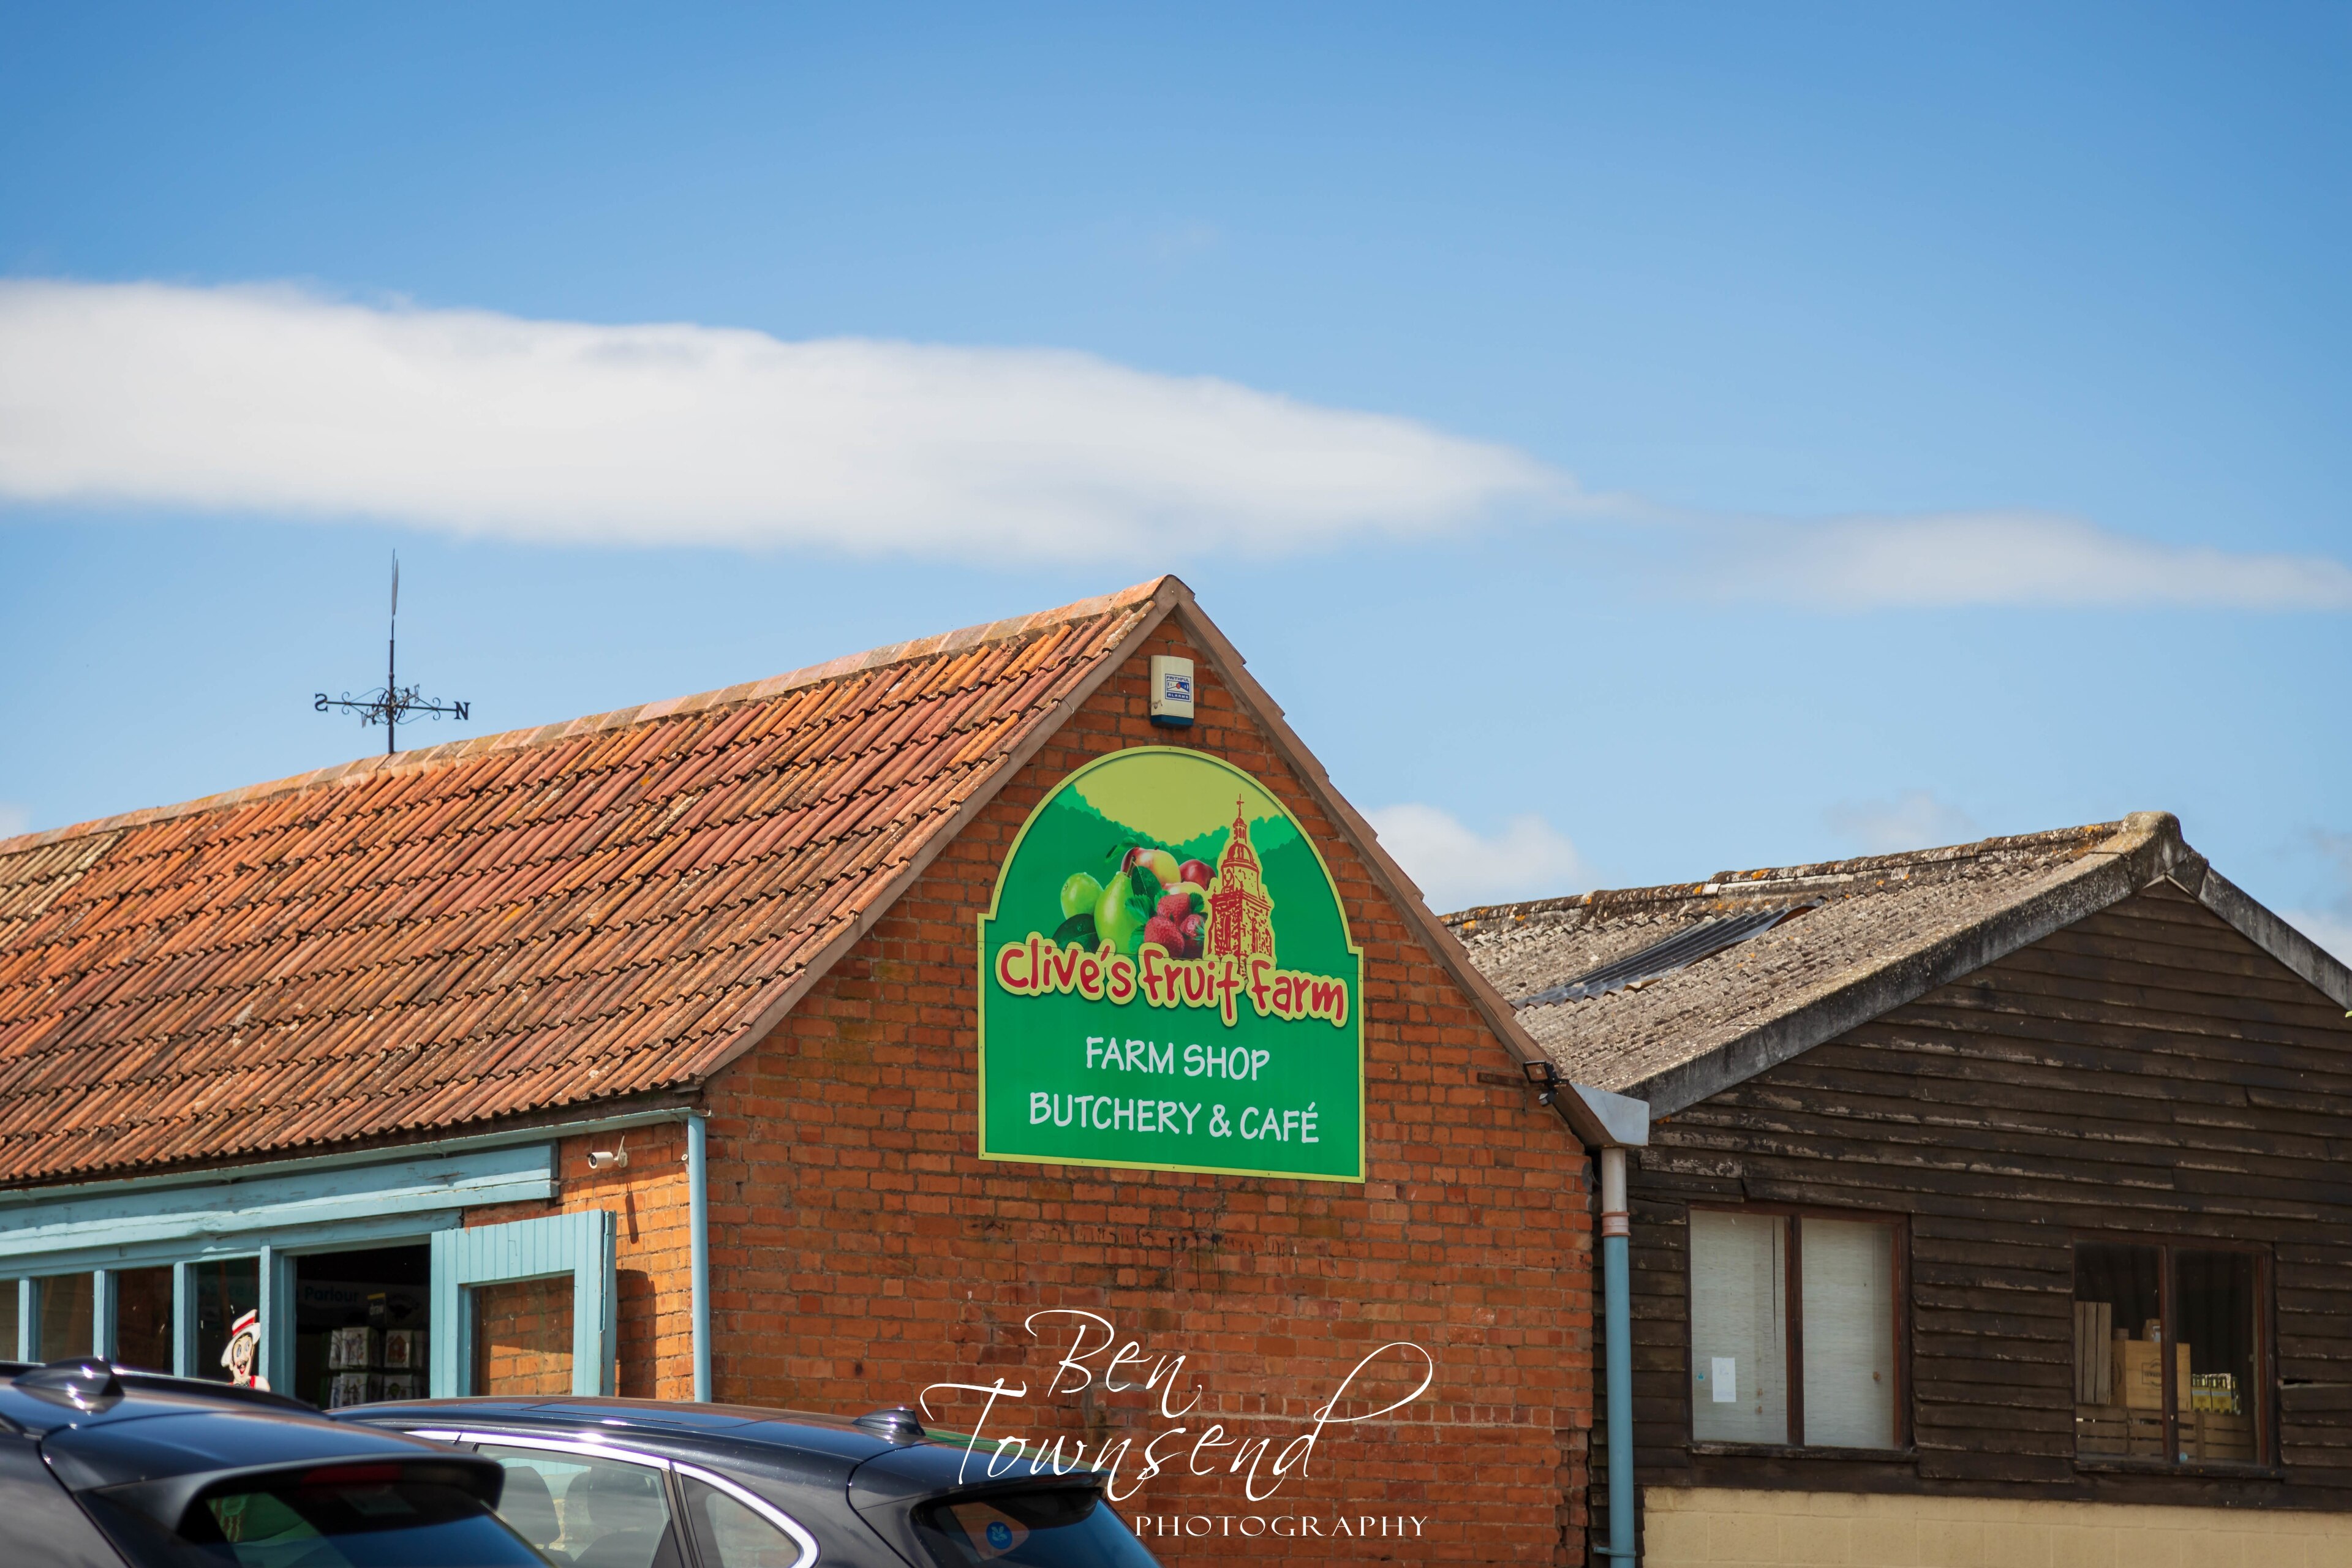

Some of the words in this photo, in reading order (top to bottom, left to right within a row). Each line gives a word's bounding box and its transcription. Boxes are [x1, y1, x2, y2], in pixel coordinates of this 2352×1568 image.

[453, 701, 471, 720] N
[1000, 938, 1132, 998] Clive's
[1142, 949, 1241, 1021] fruit
[1251, 959, 1345, 1021] farm
[1085, 1036, 1175, 1075] FARM
[1183, 1044, 1271, 1081] SHOP
[1029, 1091, 1202, 1135] BUTCHERY
[1208, 1104, 1233, 1138] &
[1239, 1102, 1320, 1144] CAFÉ
[304, 1285, 360, 1303] Parlour
